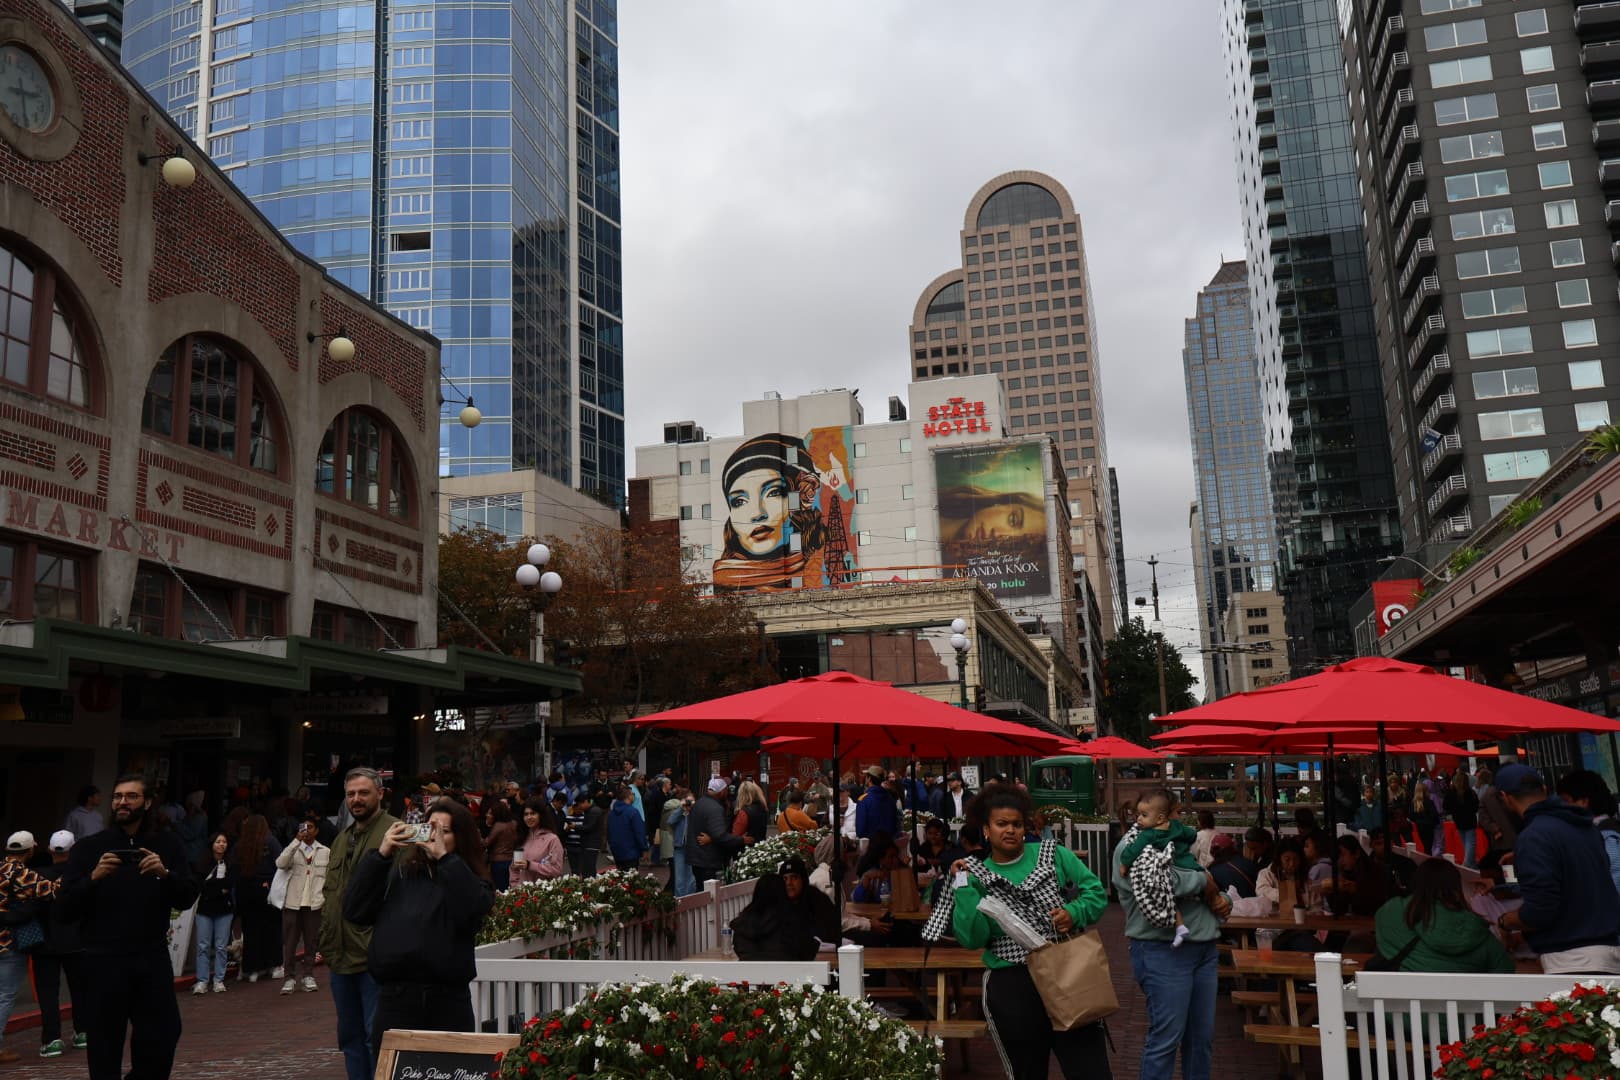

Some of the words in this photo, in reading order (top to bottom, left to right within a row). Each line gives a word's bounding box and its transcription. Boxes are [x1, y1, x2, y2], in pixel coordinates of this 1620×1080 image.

[928, 401, 985, 421] STATE
[924, 418, 991, 438] HOTEL
[5, 490, 184, 564] MARKET
[1006, 562, 1039, 574] KNOX
[1001, 578, 1025, 588] hulu
[400, 1066, 423, 1080] Pike
[425, 1067, 452, 1080] Place
[454, 1068, 488, 1080] Market
